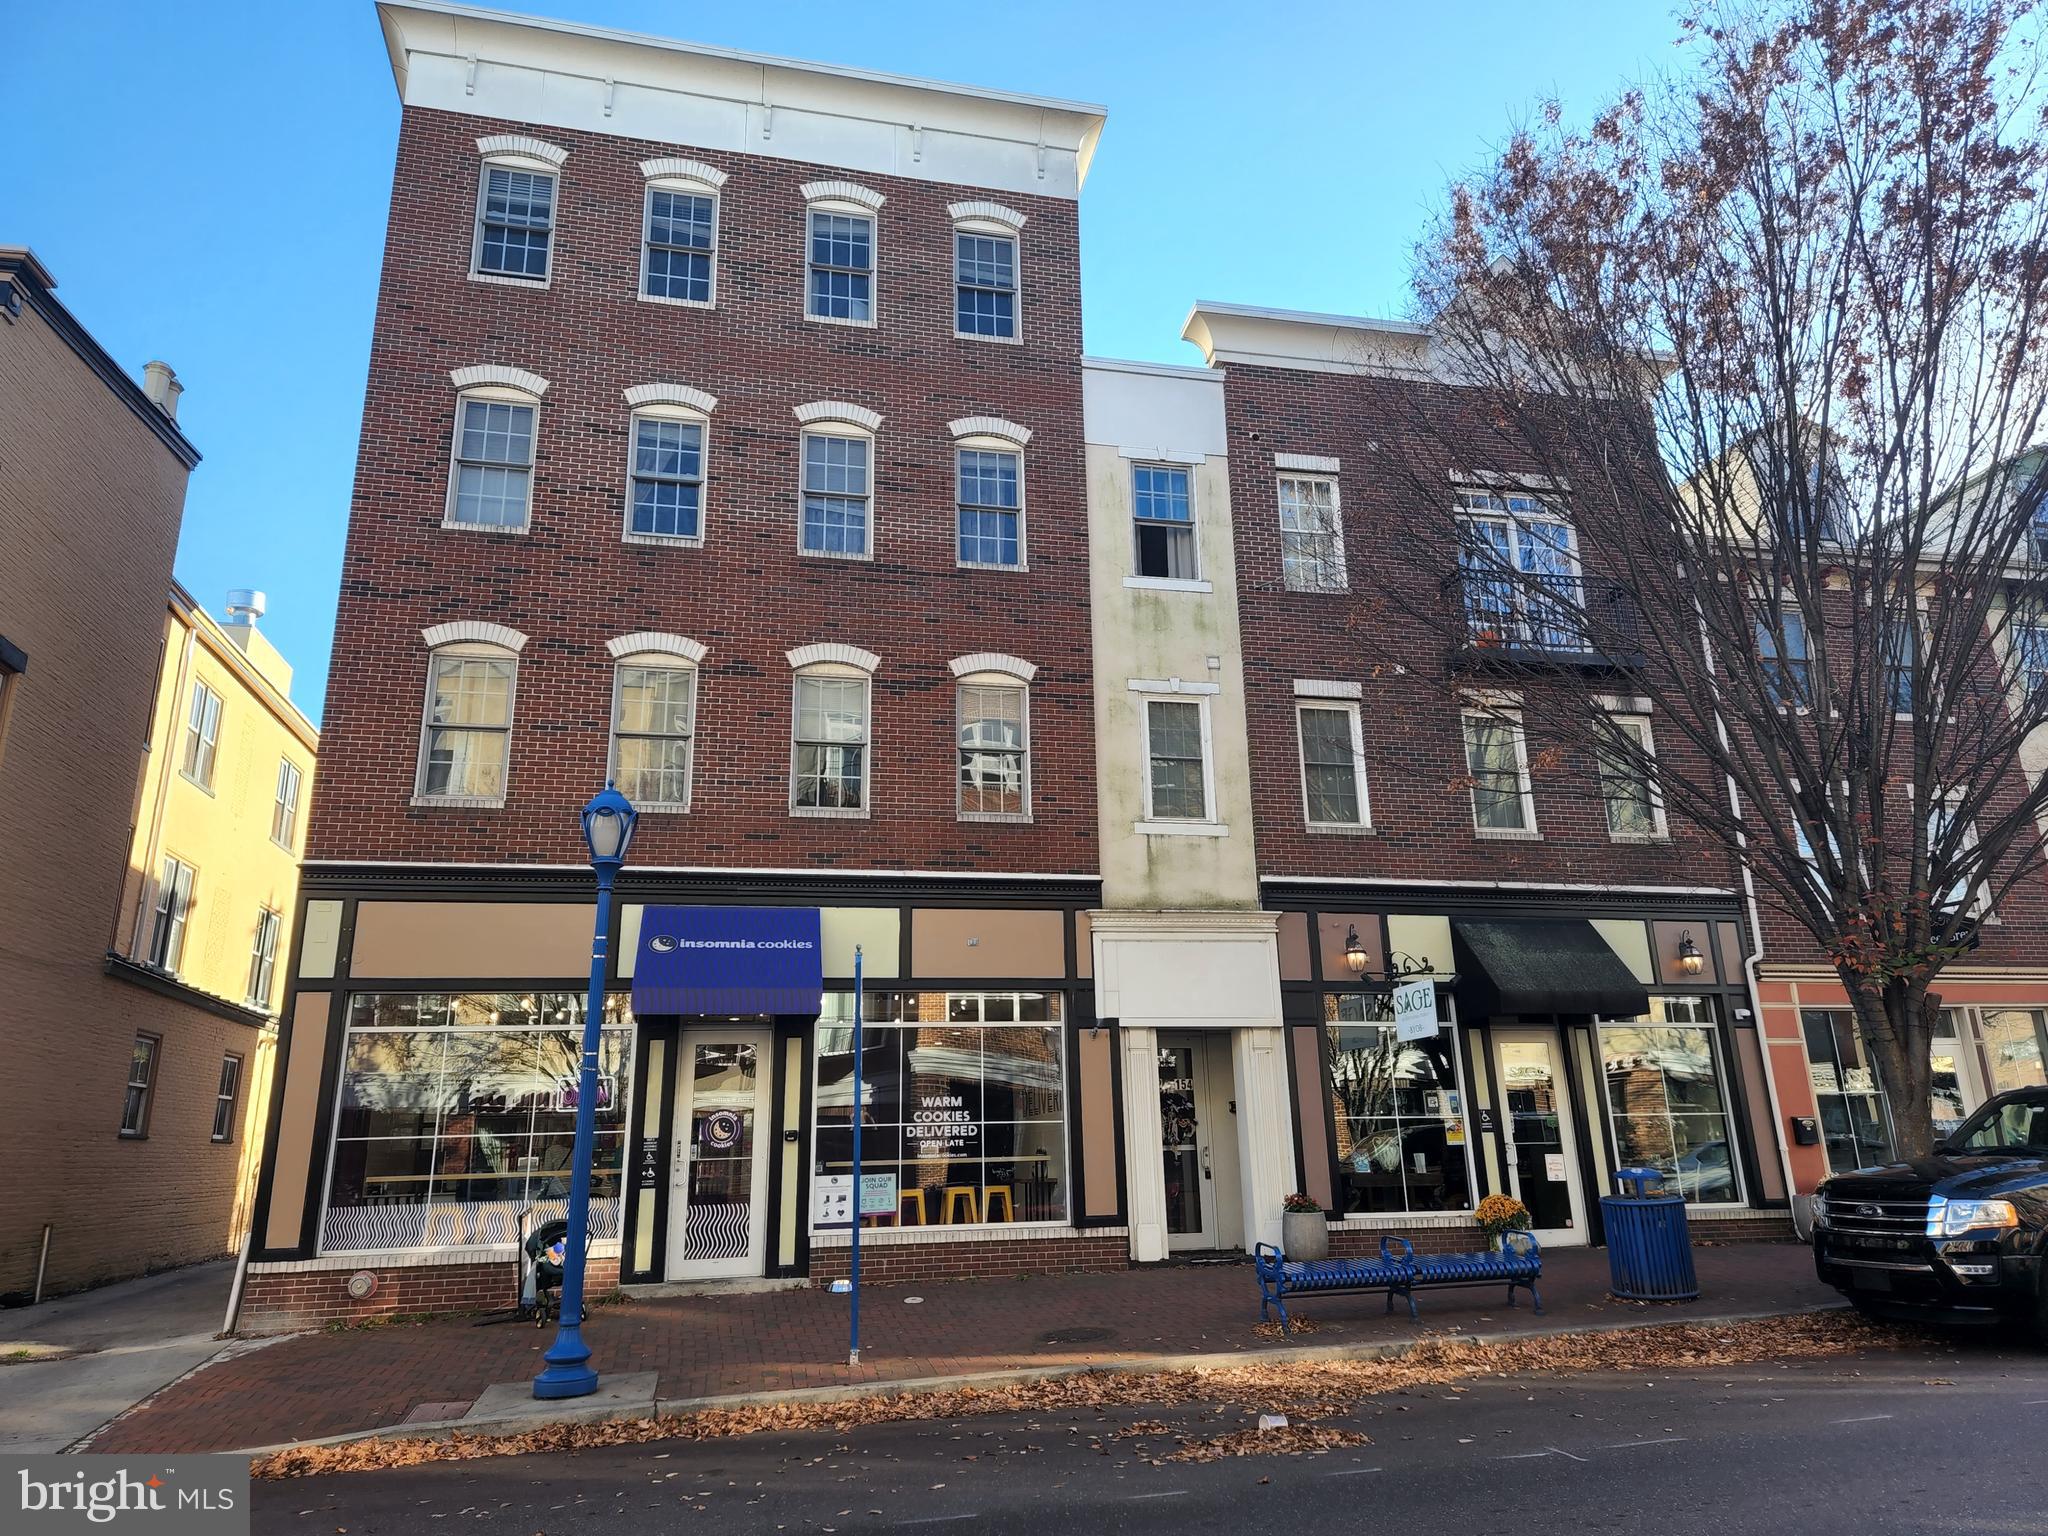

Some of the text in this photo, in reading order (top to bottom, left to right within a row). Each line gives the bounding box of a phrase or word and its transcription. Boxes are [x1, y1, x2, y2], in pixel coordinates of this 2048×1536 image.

[680, 938, 813, 949] insomnia cookies
[1396, 987, 1433, 1015] SAGE
[1175, 1079, 1193, 1090] 154
[920, 1096, 963, 1108] WARM
[709, 1110, 738, 1121] insomnia
[913, 1111, 971, 1122] COOKIES
[906, 1125, 978, 1138] DELIVERED
[710, 1140, 735, 1149] cookies
[920, 1139, 965, 1148] OPEN LATE
[866, 1182, 888, 1190] SQUAD
